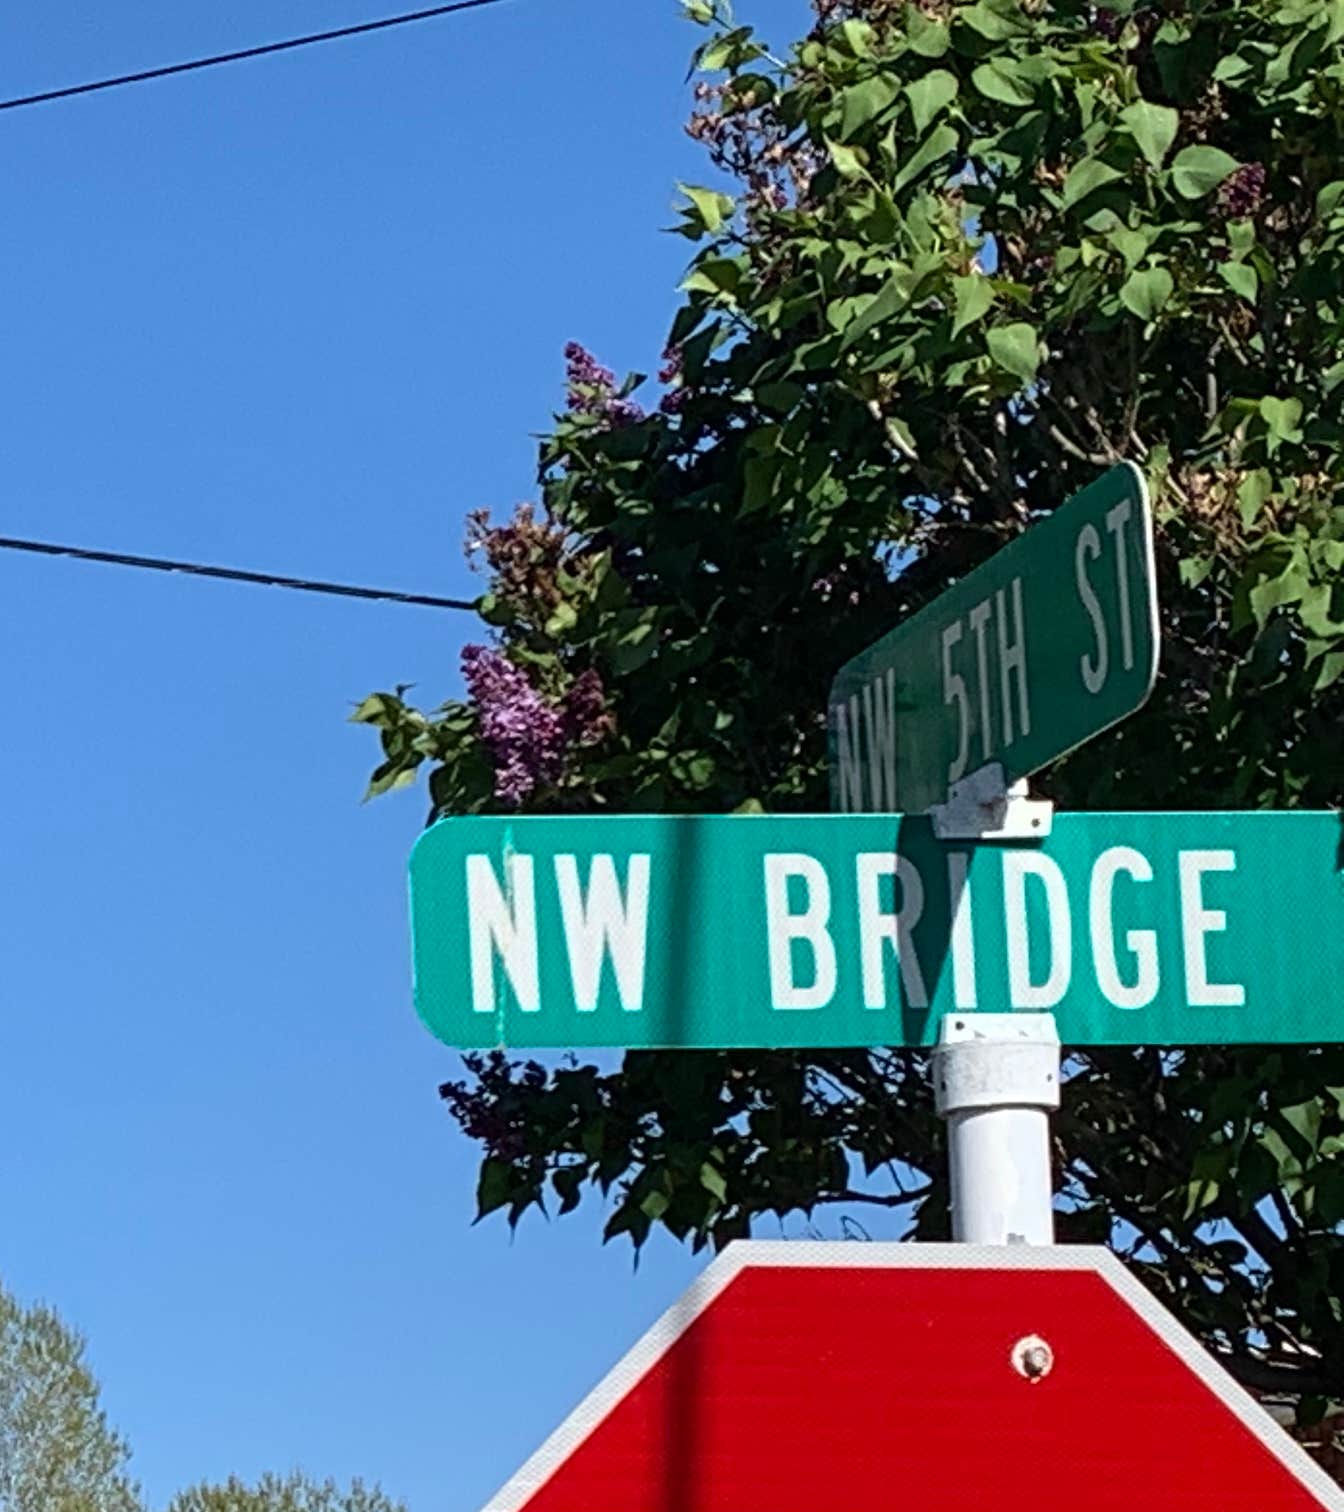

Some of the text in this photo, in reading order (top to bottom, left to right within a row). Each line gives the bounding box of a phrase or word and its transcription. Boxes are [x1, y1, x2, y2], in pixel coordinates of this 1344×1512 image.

[834, 498, 1133, 813] NW 5TH ST
[464, 846, 1246, 1012] NW BRIDGE
